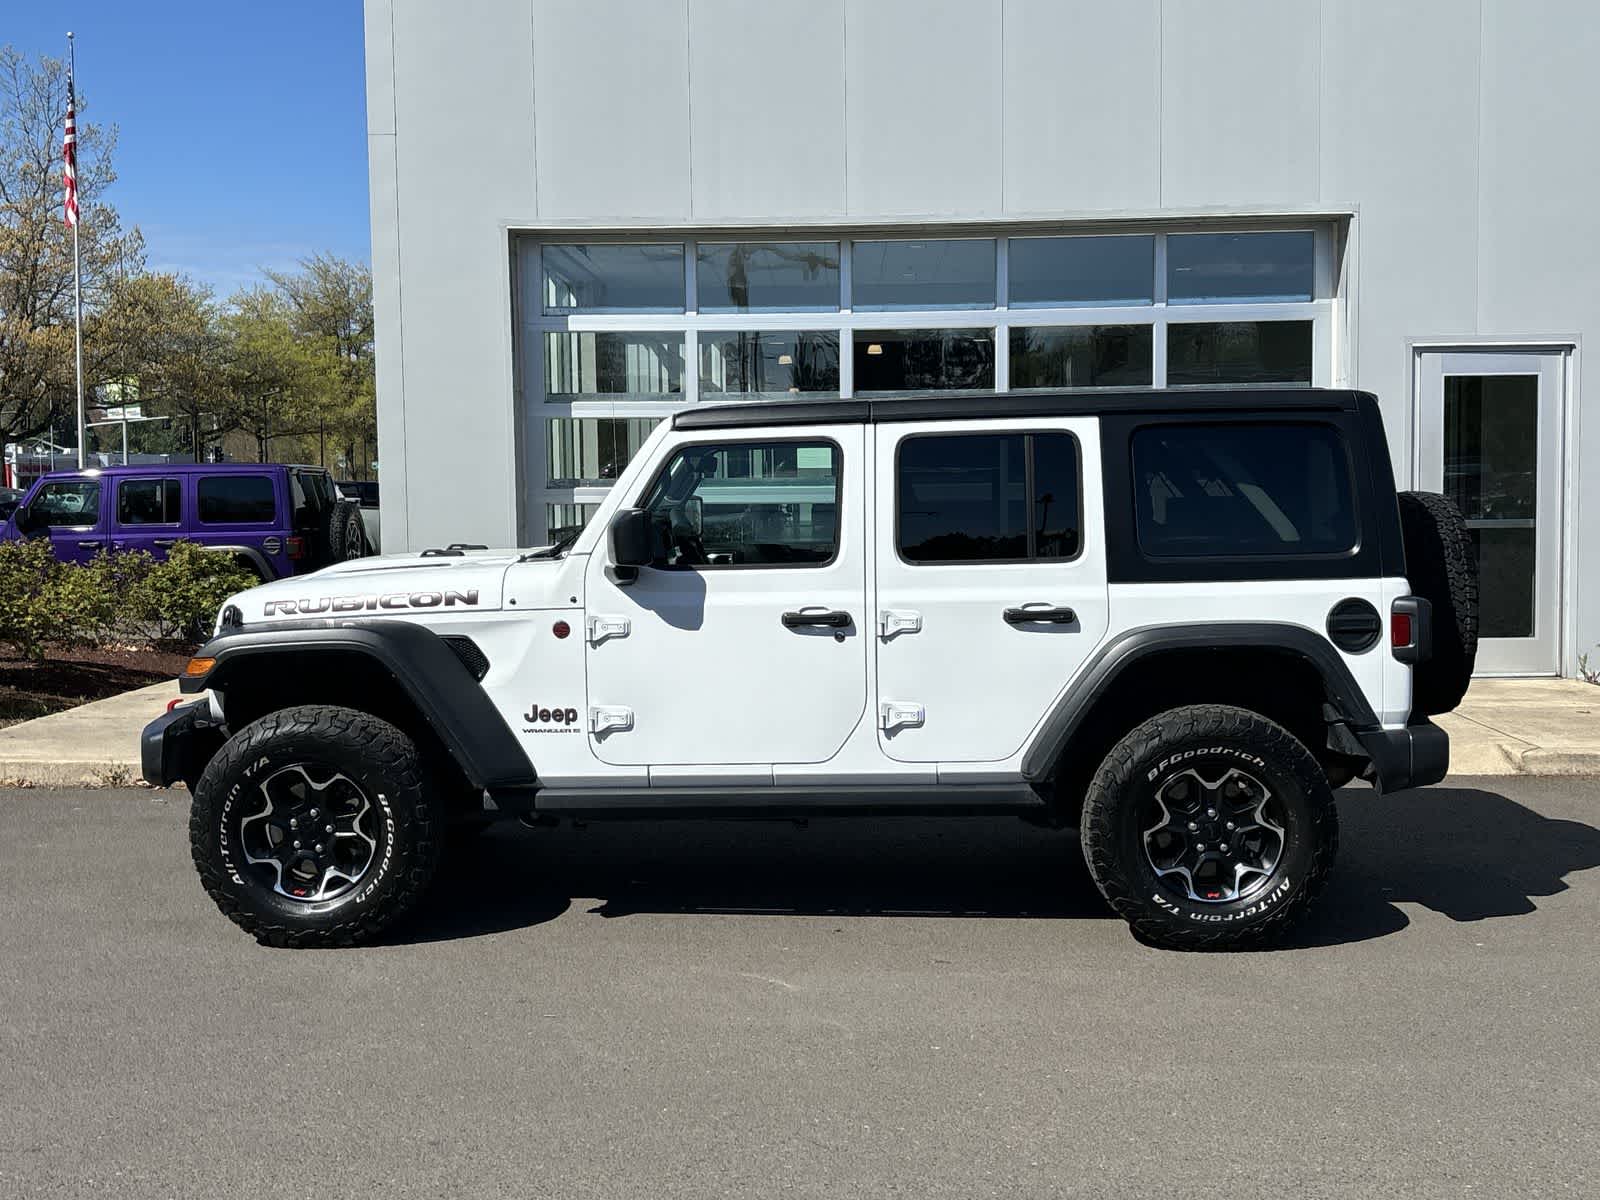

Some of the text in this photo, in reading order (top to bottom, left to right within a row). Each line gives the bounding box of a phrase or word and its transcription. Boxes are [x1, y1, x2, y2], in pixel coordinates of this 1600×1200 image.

[264, 589, 479, 616] RUBICON
[523, 704, 578, 726] Jeep
[243, 756, 270, 777] T/A
[1148, 746, 1265, 782] BFGoodrich
[355, 793, 395, 904] BFGoodrich
[1152, 893, 1180, 916] T/A
